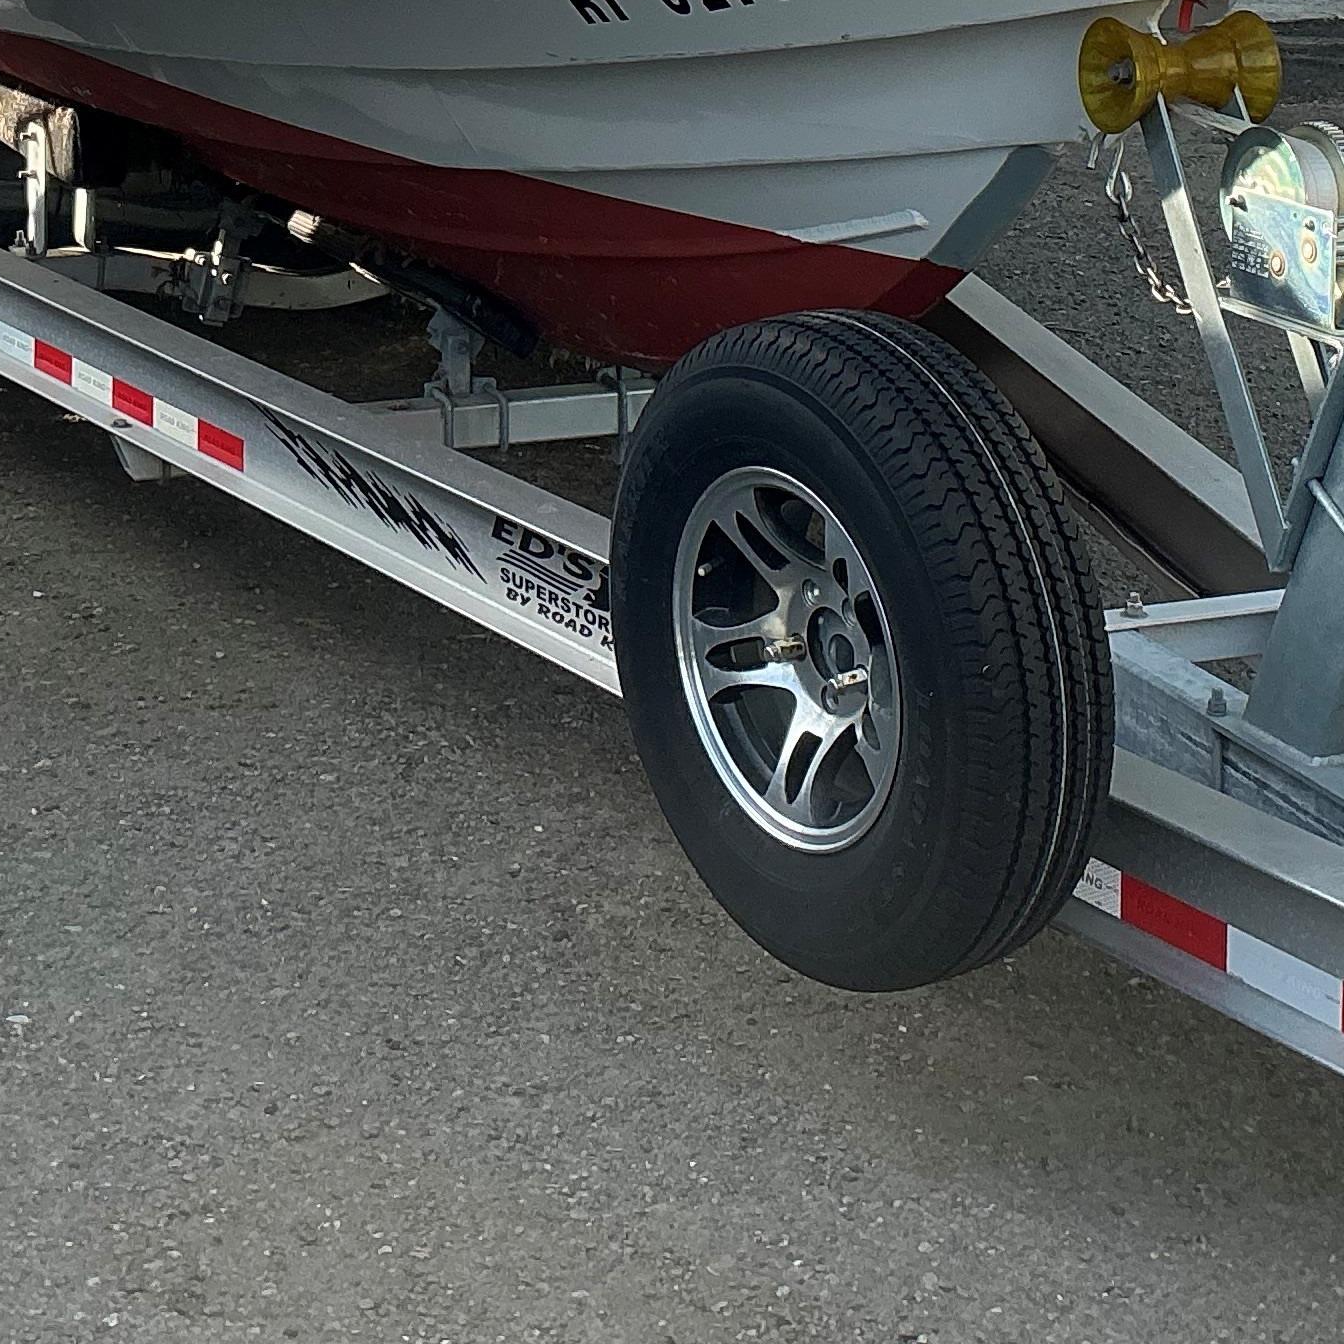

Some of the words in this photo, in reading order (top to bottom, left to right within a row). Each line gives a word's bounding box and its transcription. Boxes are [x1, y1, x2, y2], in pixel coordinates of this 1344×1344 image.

[491, 515, 594, 581] ED'S
[500, 567, 611, 634] SUPERSTOR
[505, 587, 532, 606] BY
[537, 602, 594, 637] ROAD
[1081, 872, 1103, 890] ING
